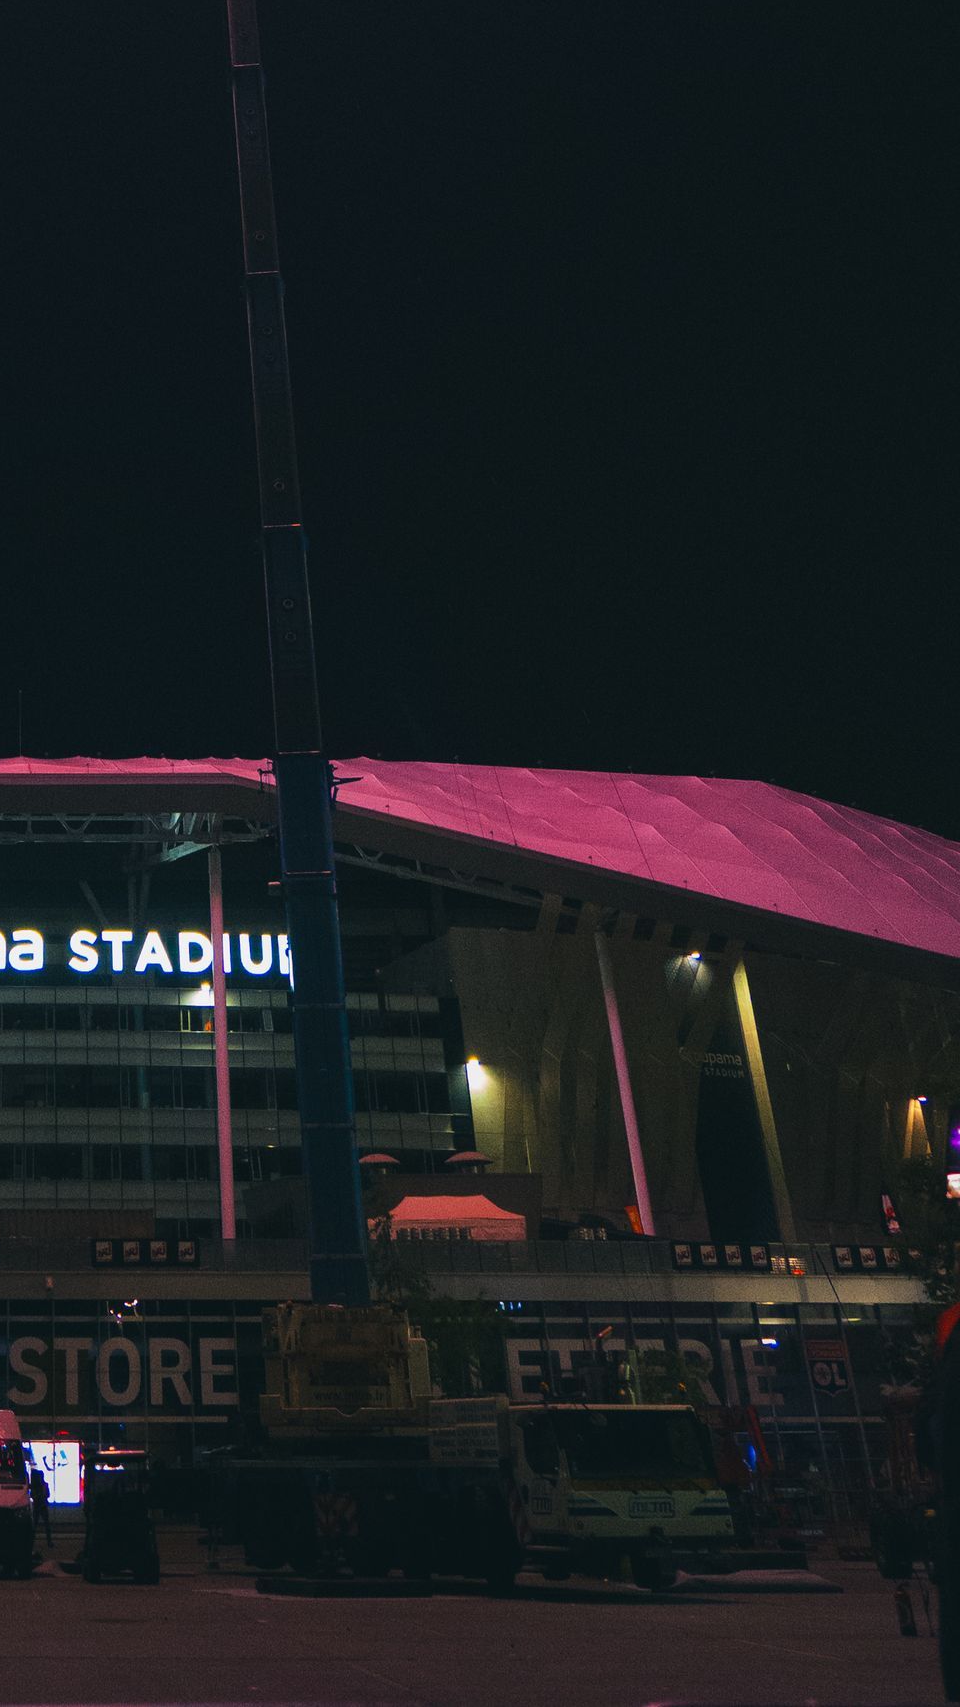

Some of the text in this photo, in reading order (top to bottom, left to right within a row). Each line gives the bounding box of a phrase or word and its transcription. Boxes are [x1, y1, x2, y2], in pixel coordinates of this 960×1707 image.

[68, 929, 291, 975] STADIU
[7, 1336, 238, 1406] STORE
[813, 1362, 846, 1386] OL
